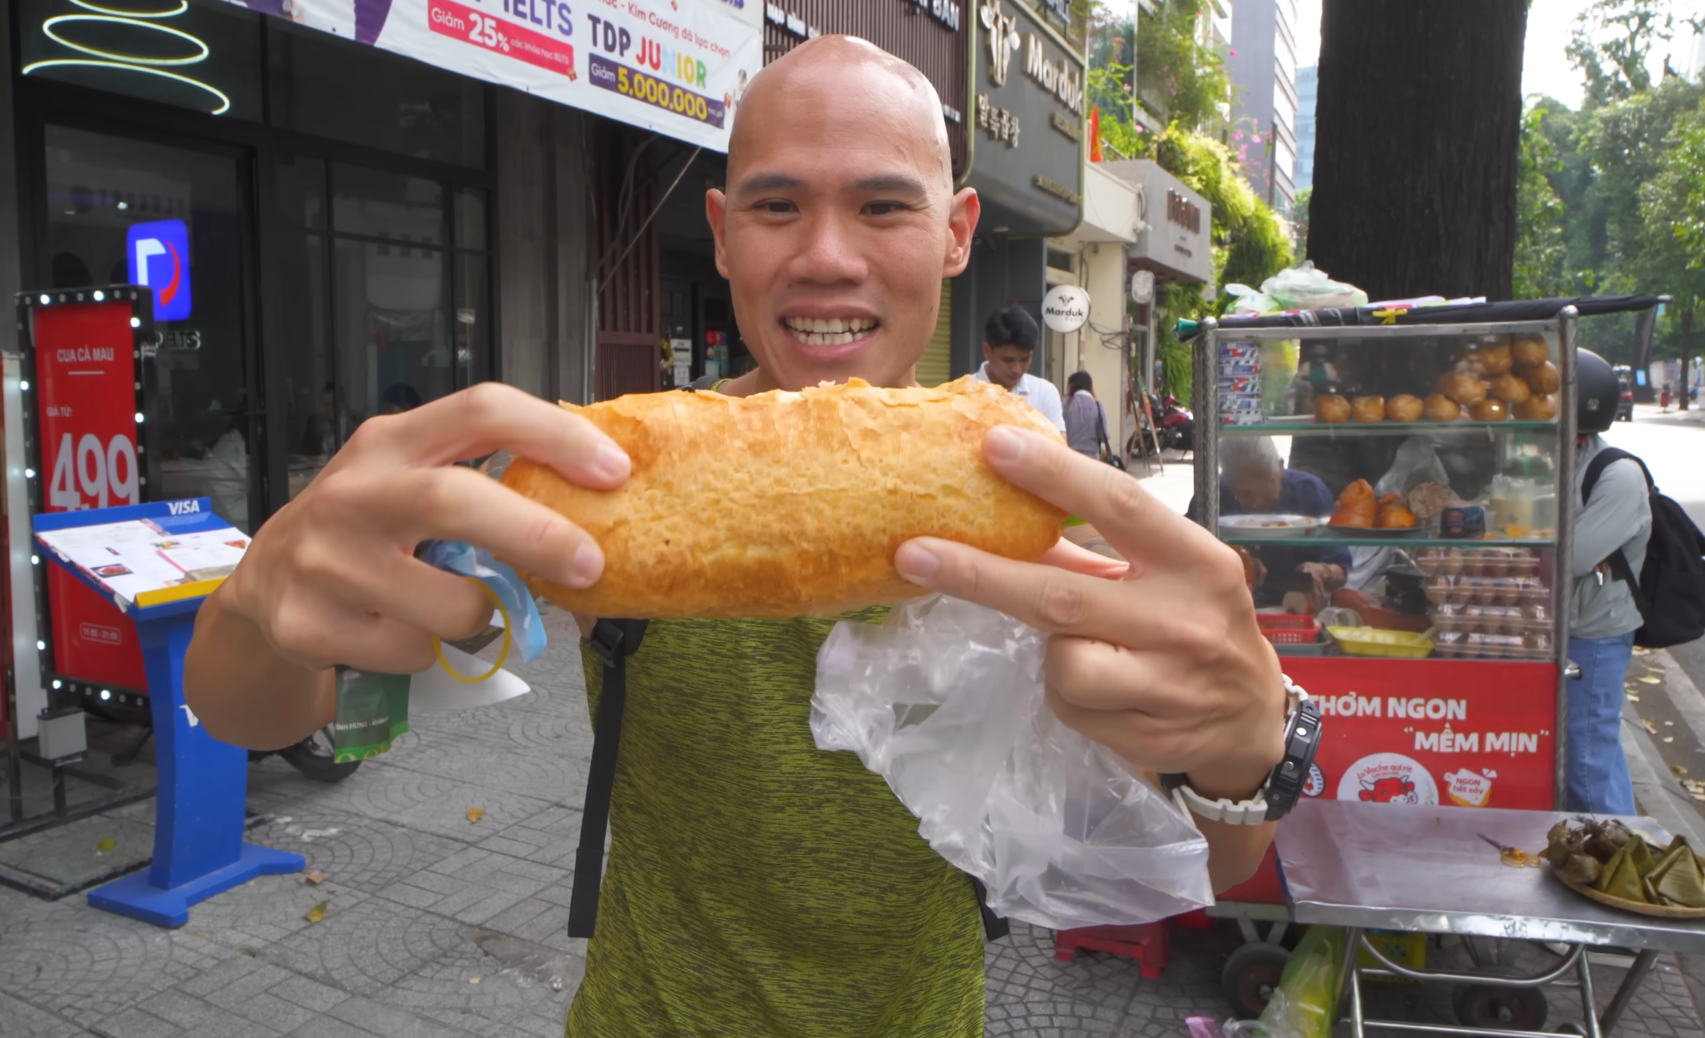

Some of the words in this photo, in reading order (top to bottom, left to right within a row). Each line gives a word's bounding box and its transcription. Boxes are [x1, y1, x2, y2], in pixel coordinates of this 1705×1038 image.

[628, 2, 646, 21] Kim
[431, 7, 465, 31] Giảm
[468, 12, 510, 52] 25%
[587, 13, 631, 57] TDP
[636, 36, 707, 89] JUNIOR
[1024, 32, 1082, 115] Marduk
[591, 63, 616, 83] Giảm
[617, 66, 707, 120] 5.000.000
[1045, 307, 1084, 317] Marduk
[57, 348, 76, 362] CUA
[77, 344, 91, 362] CÀ
[92, 347, 115, 361] MAU
[49, 432, 139, 512] 499
[166, 500, 200, 515] VISA
[1387, 697, 1466, 720] NGON
[1456, 778, 1480, 786] NGON
